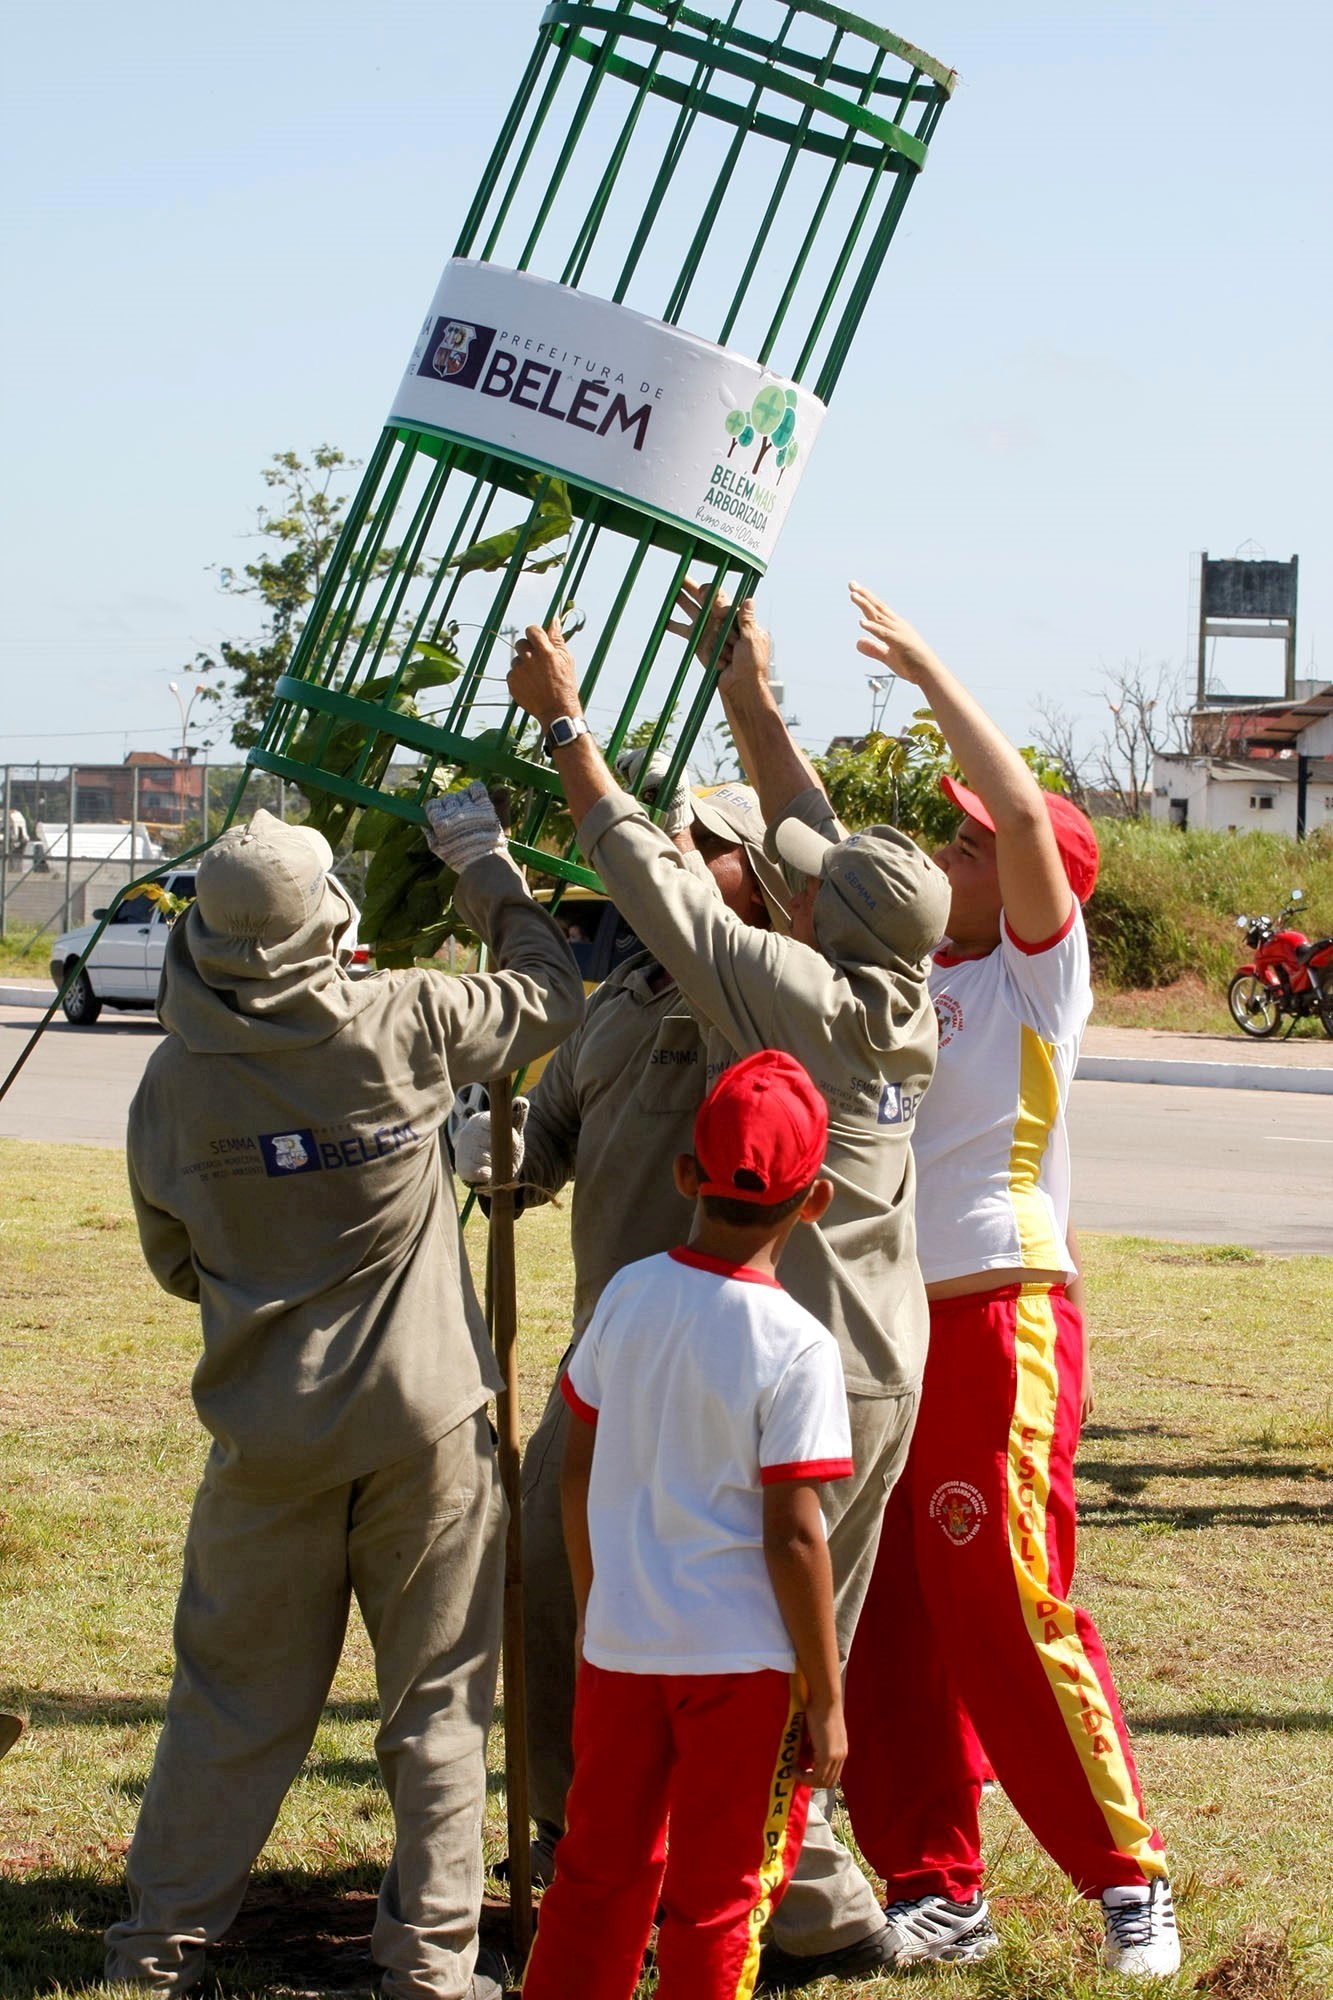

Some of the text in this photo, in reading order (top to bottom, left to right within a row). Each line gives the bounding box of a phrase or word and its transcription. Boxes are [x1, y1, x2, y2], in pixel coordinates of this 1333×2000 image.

[499, 331, 664, 400] PREFEITURA DE
[480, 349, 653, 452] BELÉM
[703, 486, 768, 534] ARBORIZADA
[710, 463, 777, 513] BELÉM MAIS
[650, 1048, 698, 1065] SEMMA
[849, 1077, 881, 1099] SEMMA
[209, 1137, 257, 1154] SEMMA
[319, 1120, 419, 1169] BELÉM
[1036, 1600, 1064, 1644] DA
[1059, 1659, 1113, 1761] VIDA
[772, 1711, 806, 1817] ESCOLA
